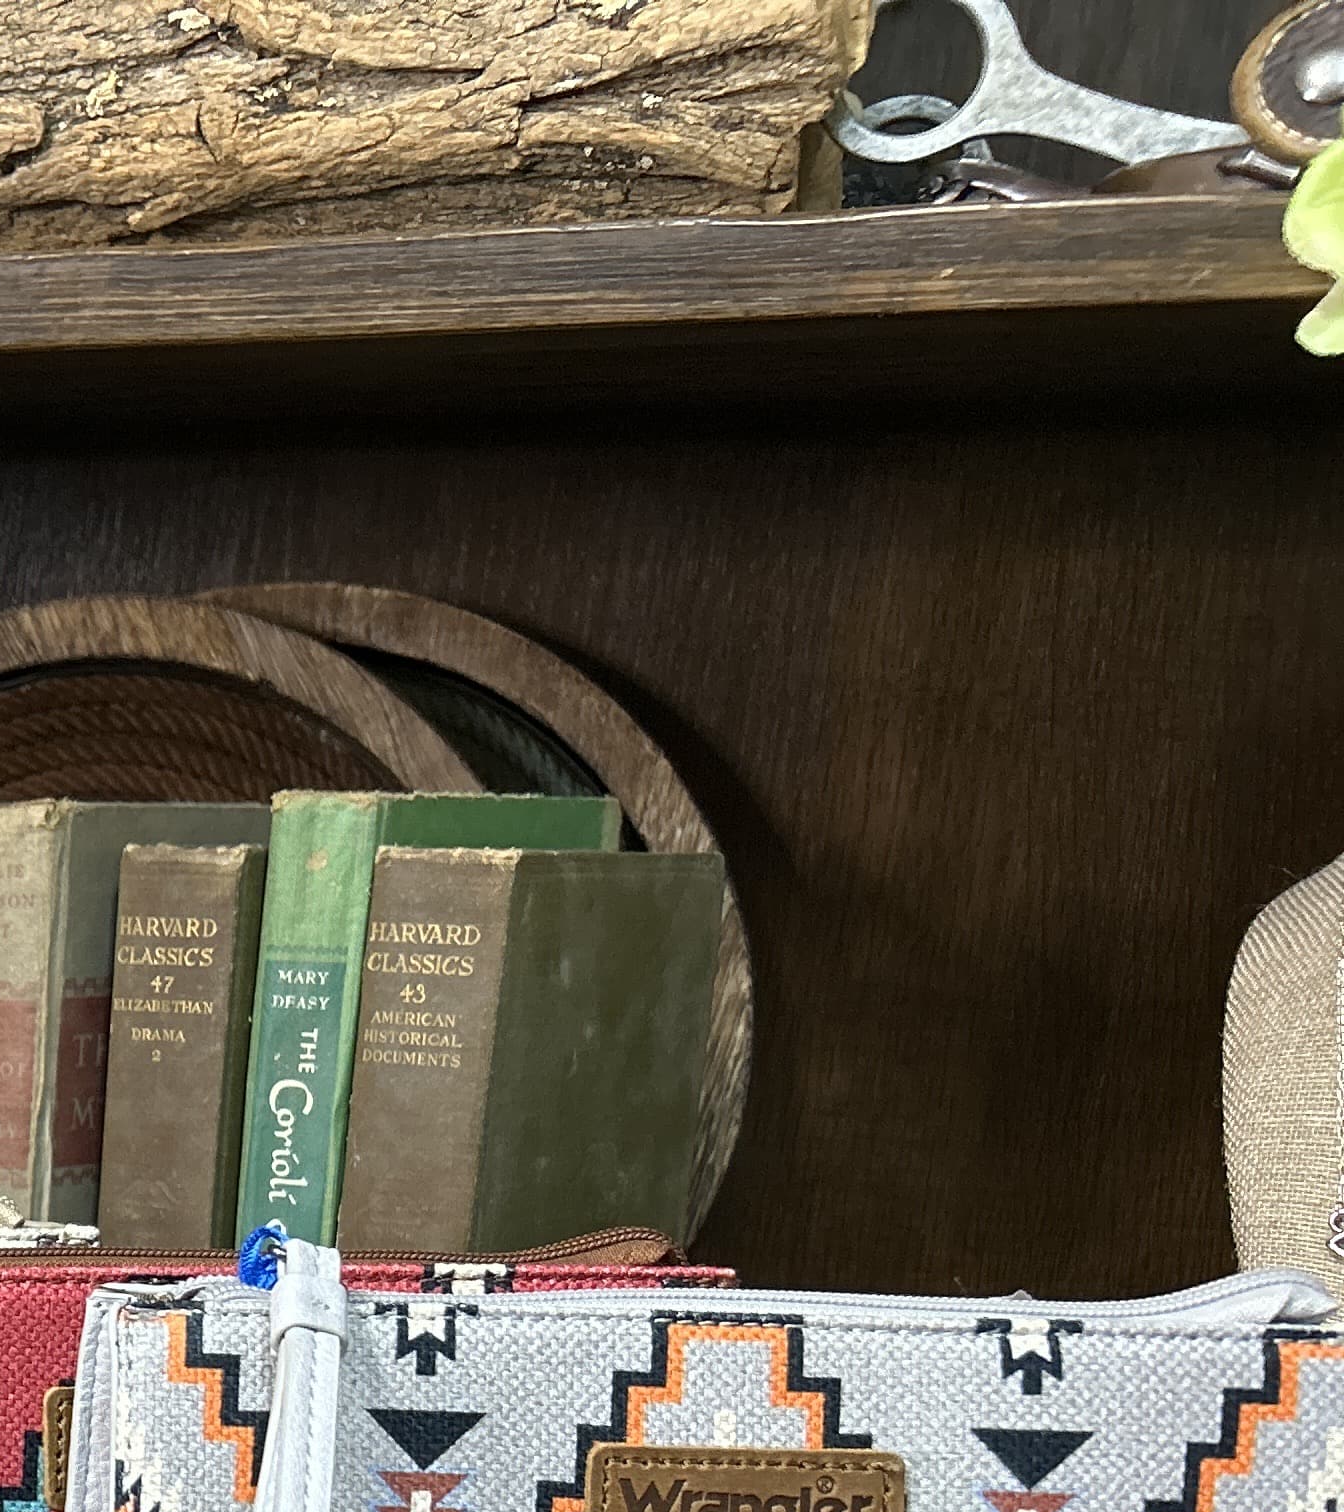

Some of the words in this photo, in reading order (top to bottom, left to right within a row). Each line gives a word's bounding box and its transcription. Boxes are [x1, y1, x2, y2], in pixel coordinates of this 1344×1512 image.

[120, 916, 218, 938] HARVARD
[369, 921, 482, 946] HARVARD
[117, 945, 215, 967] CLASSICS
[367, 951, 475, 977] CLASSICS
[150, 975, 175, 994] 47
[278, 969, 329, 985] MARY
[272, 995, 330, 1010] DEASY
[399, 983, 427, 1004] 43
[112, 997, 214, 1015] ELIZABETHAN
[370, 1010, 456, 1028] AMERICAN
[131, 1027, 187, 1043] DRAMA
[364, 1028, 463, 1048] HISTORICAL
[151, 1049, 161, 1062] 2
[298, 1027, 319, 1074] THE
[362, 1049, 461, 1069] DOCUMENTS
